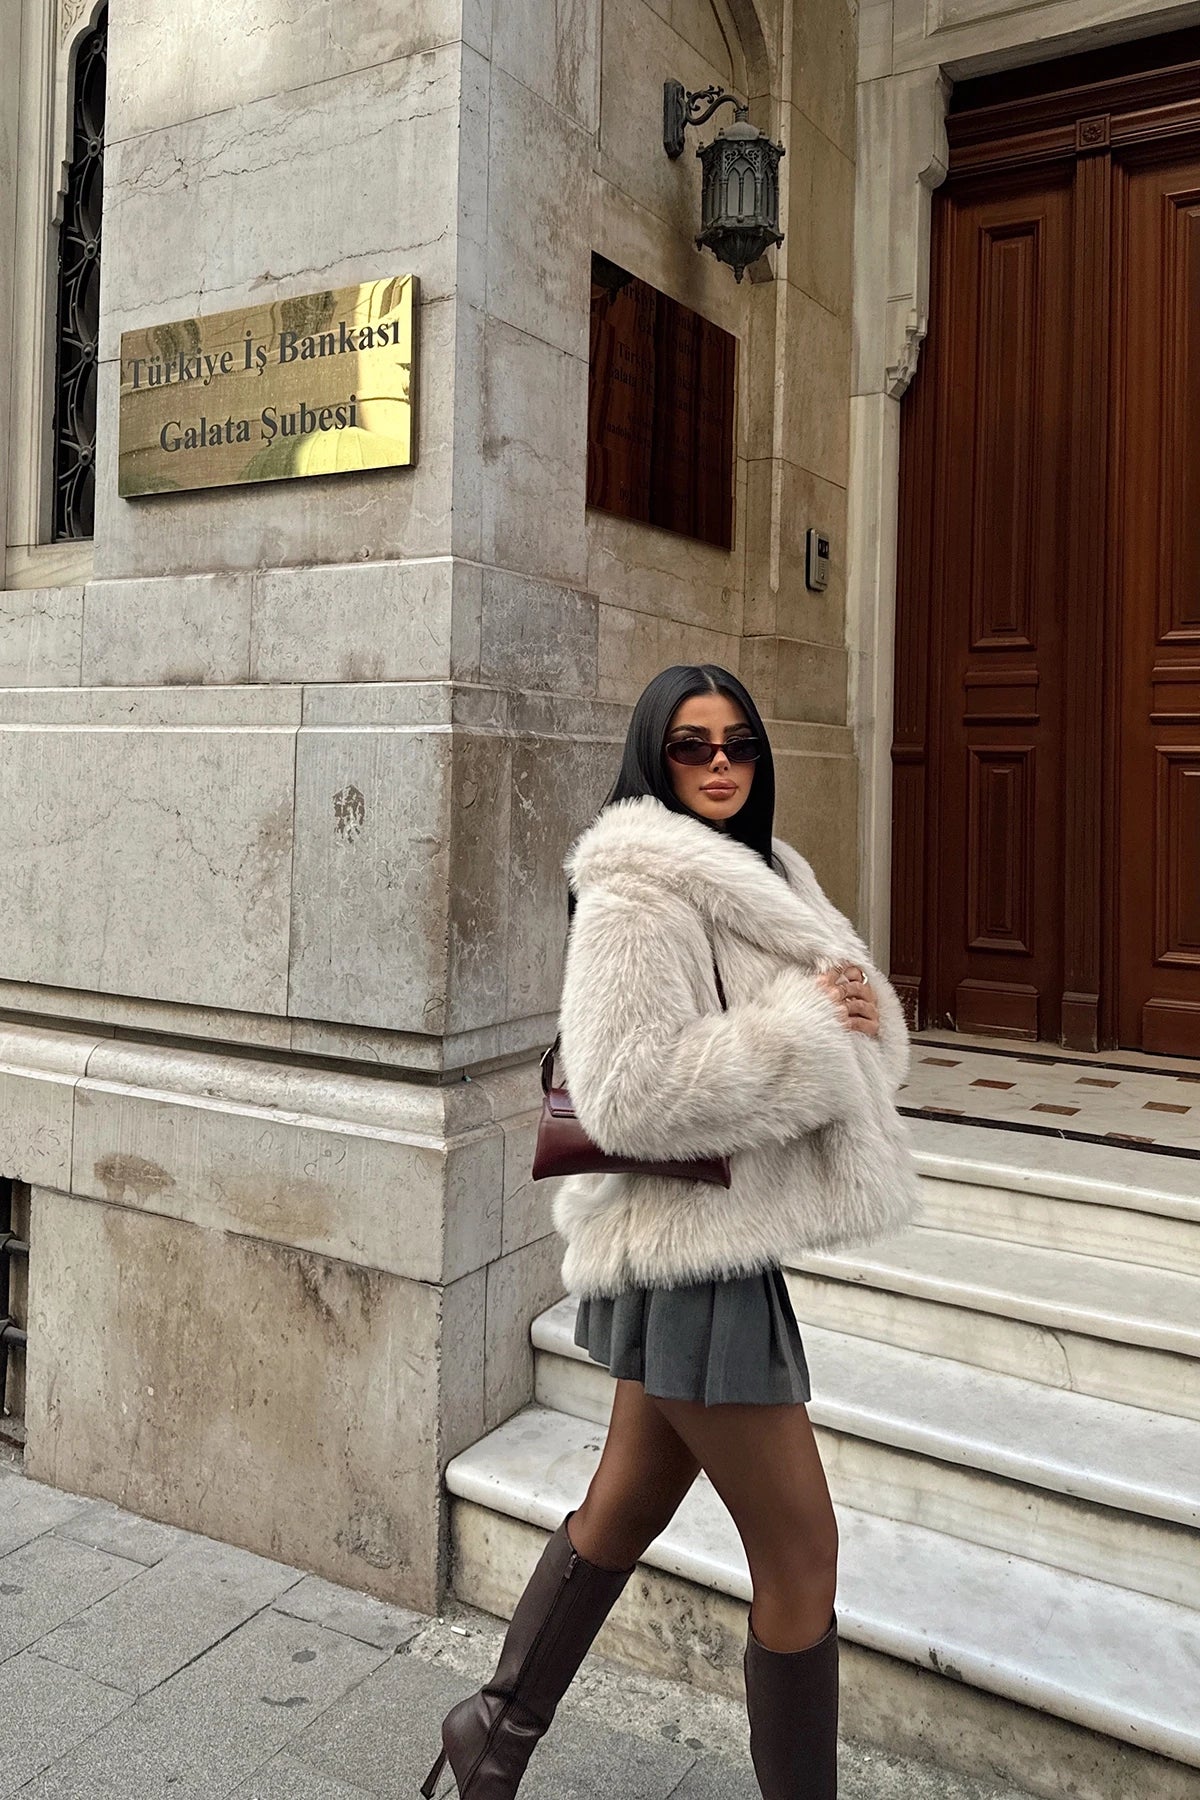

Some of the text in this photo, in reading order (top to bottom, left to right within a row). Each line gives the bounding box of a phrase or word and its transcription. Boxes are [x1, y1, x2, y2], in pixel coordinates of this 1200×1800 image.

[128, 321, 400, 387] Türkiye İş Bankası
[159, 394, 358, 453] Galata Şubesi
